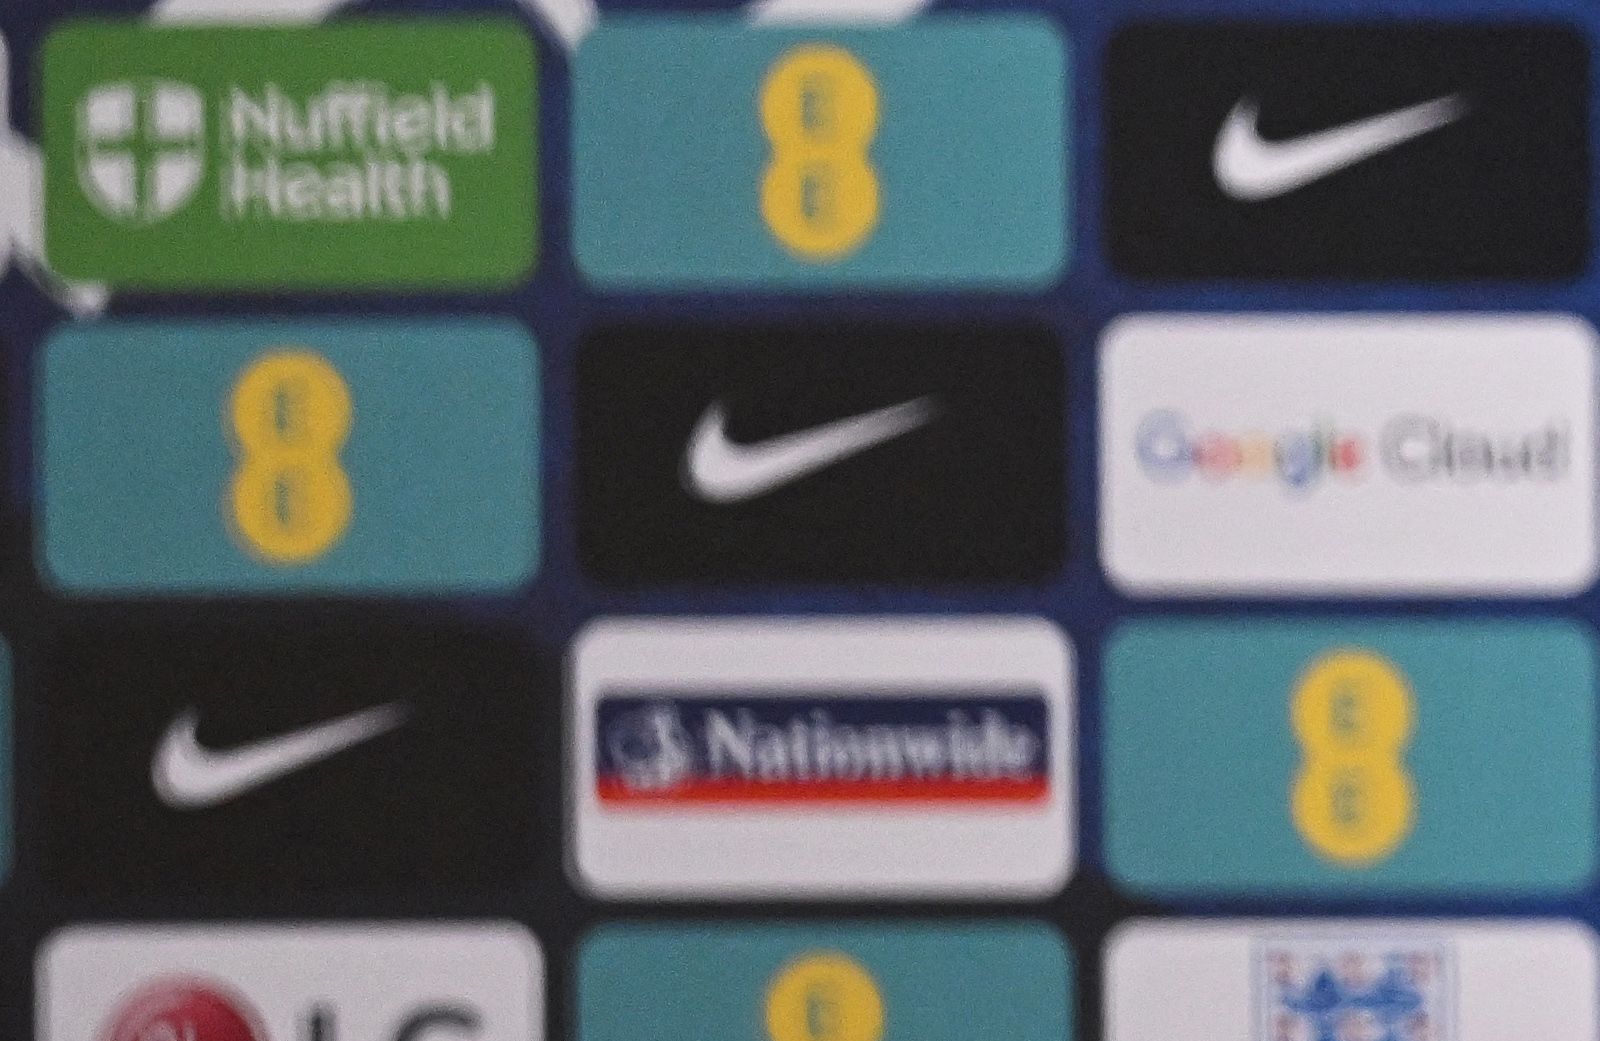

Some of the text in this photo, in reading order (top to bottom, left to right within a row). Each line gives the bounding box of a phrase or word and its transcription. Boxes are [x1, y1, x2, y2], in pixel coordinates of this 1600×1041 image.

[219, 81, 497, 154] Nuffield
[219, 155, 453, 220] Health
[703, 706, 1040, 782] Nationwide
